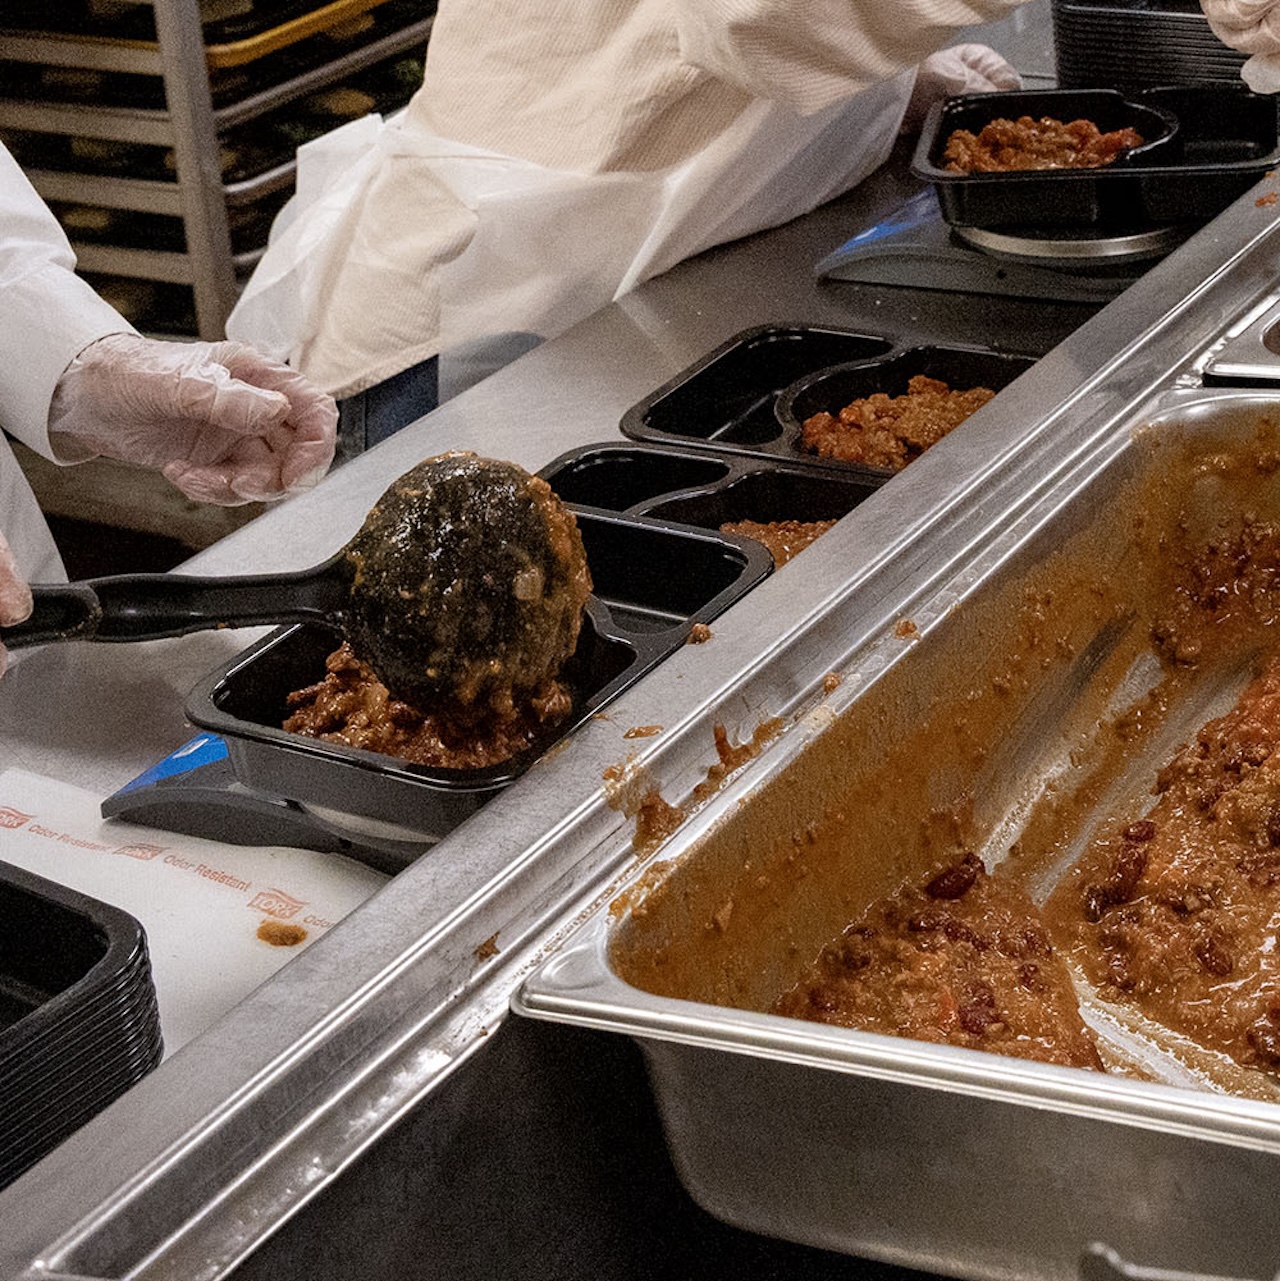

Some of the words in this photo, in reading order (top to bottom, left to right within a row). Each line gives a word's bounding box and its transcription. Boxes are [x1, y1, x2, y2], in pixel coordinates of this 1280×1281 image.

[28, 824, 58, 839] Odor
[163, 854, 196, 871] Odor
[194, 863, 252, 893] Resistant
